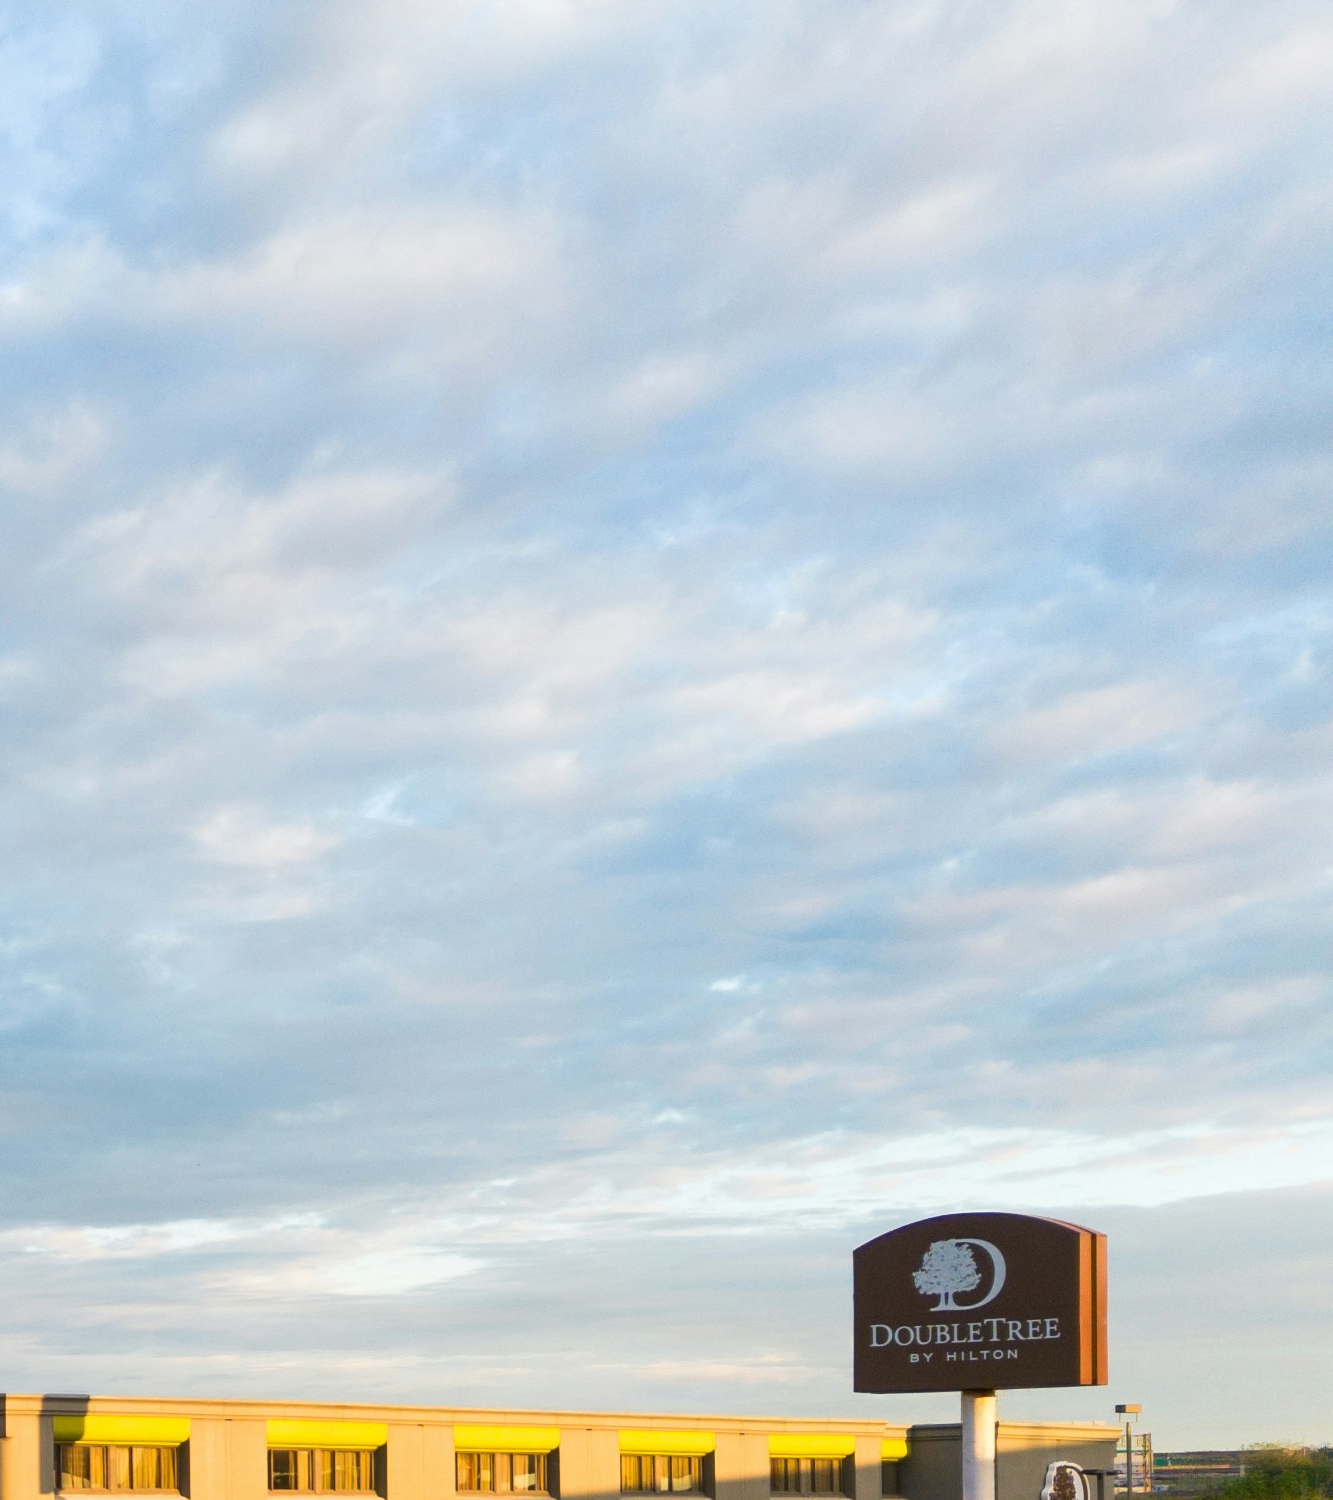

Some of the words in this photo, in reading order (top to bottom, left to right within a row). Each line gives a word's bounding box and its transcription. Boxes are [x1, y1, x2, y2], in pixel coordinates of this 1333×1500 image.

[870, 1318, 1061, 1347] DOUBLETREE
[910, 1353, 933, 1363] BY
[946, 1350, 1019, 1362] HILTON
